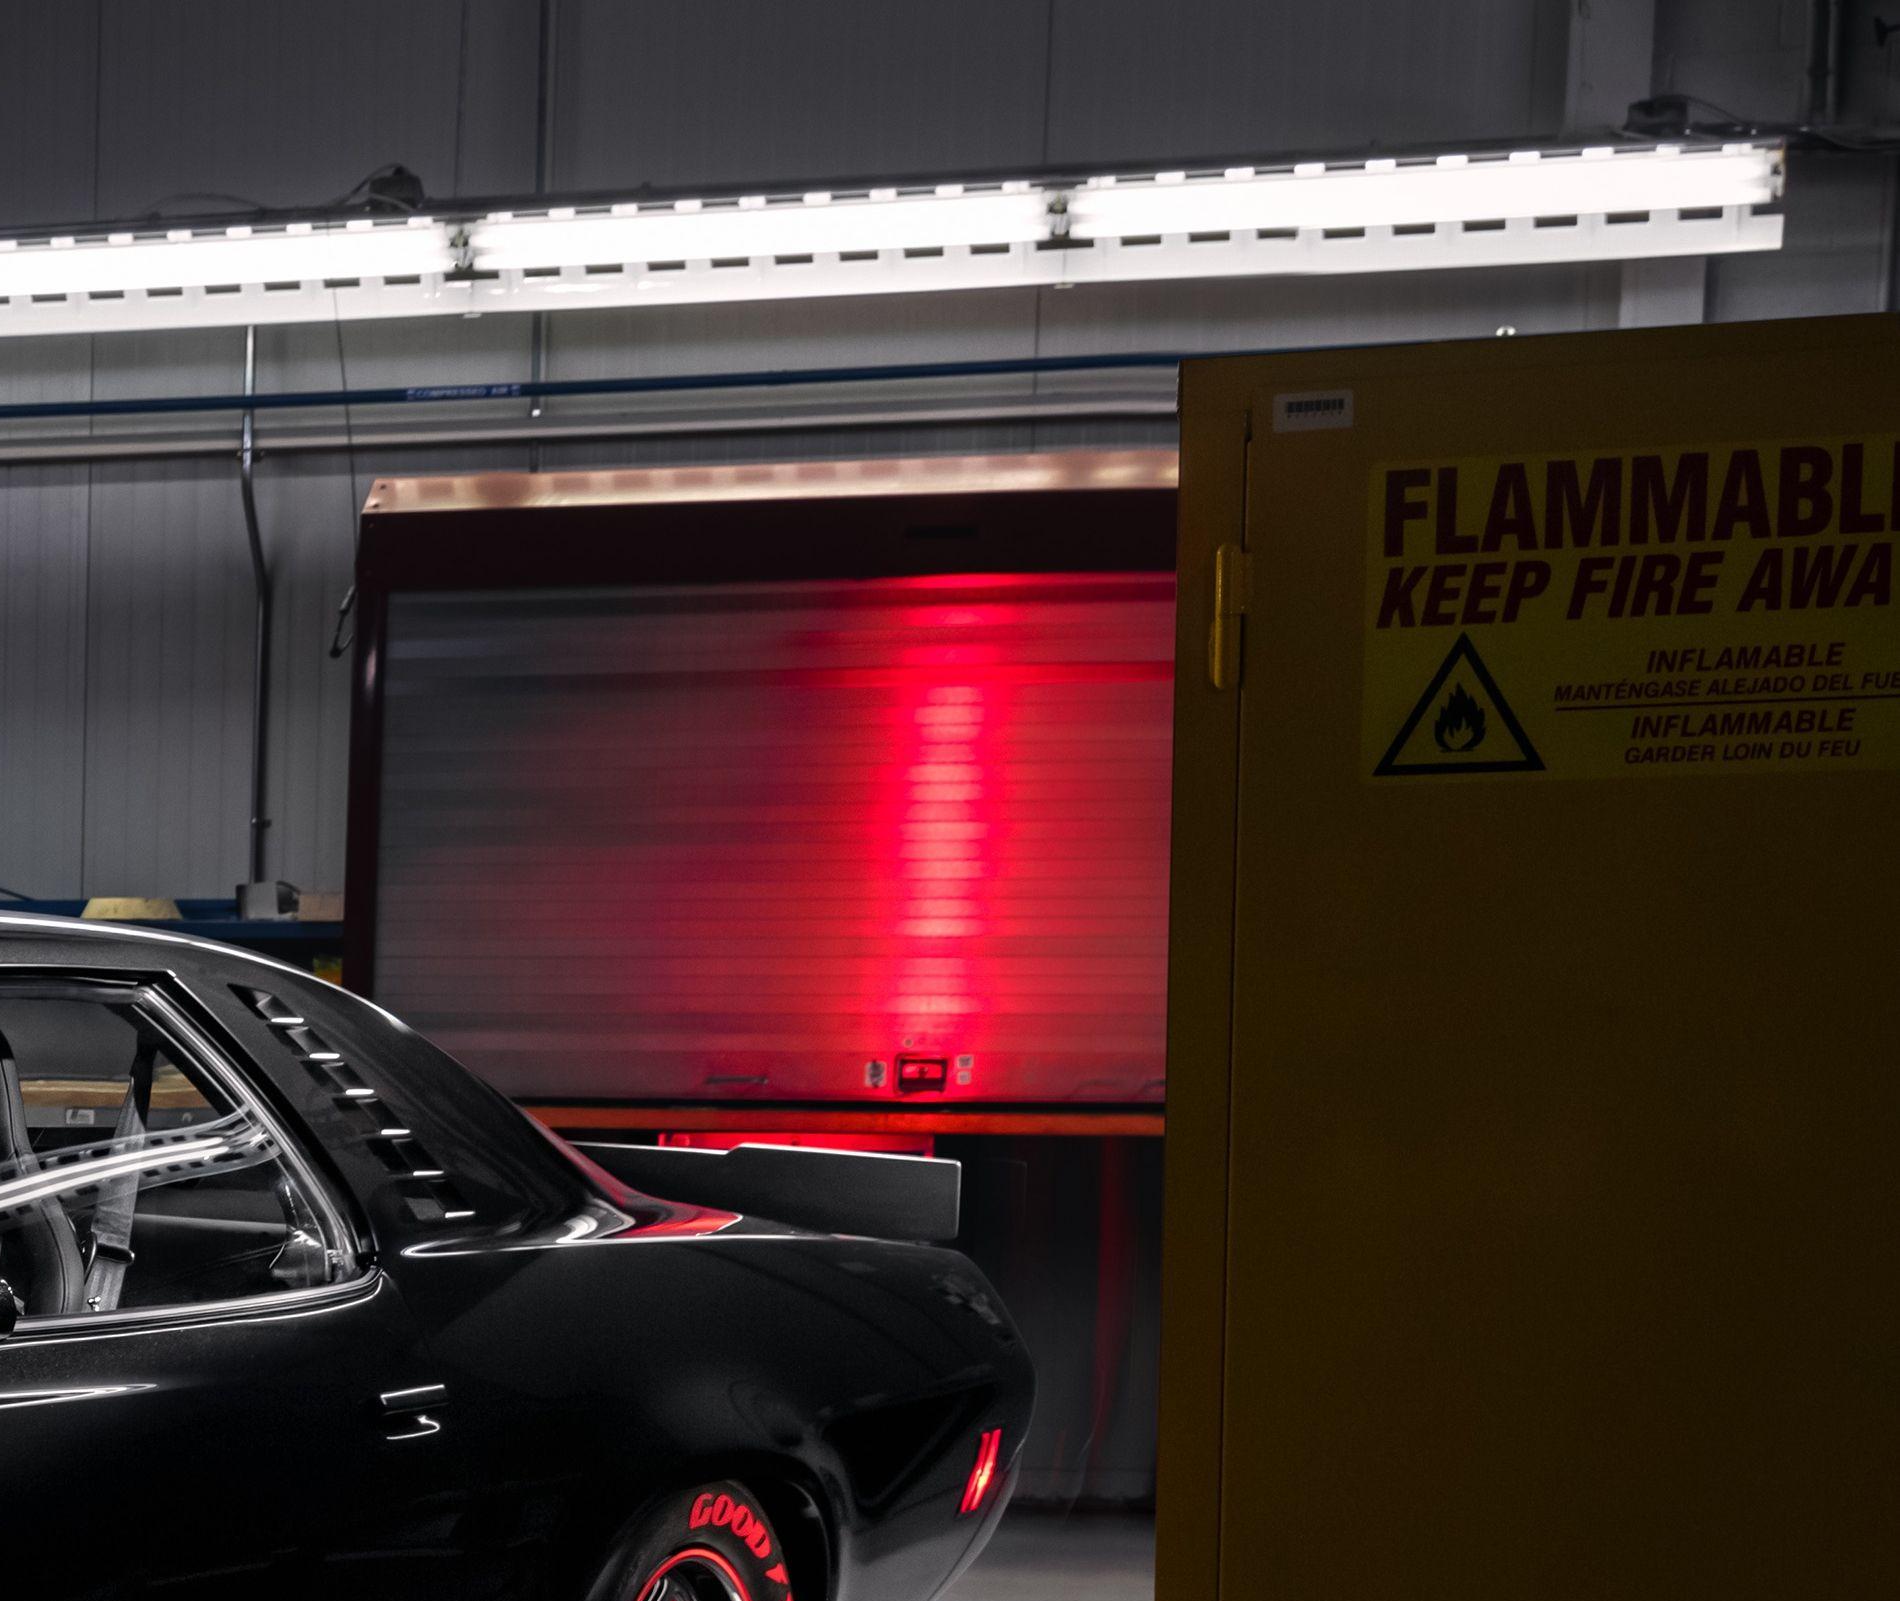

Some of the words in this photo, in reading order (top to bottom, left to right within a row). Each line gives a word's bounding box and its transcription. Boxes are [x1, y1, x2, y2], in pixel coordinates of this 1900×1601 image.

[1383, 441, 1900, 557] FLAMMABL
[1376, 559, 1551, 628] KEEP
[1566, 551, 1725, 620] FIRE
[1736, 542, 1893, 613] AWA
[1646, 642, 1846, 674] INFLAMABLE
[1554, 678, 1701, 702] MANTÉNGASE
[1705, 675, 1806, 698] ALEJADO
[1811, 672, 1854, 692] DEL
[1631, 708, 1856, 738] INFLAMMABLE
[1624, 743, 1716, 764] GARDER
[1721, 741, 1776, 761] LOIN
[1780, 740, 1813, 759] DU
[1817, 739, 1861, 757] FEU
